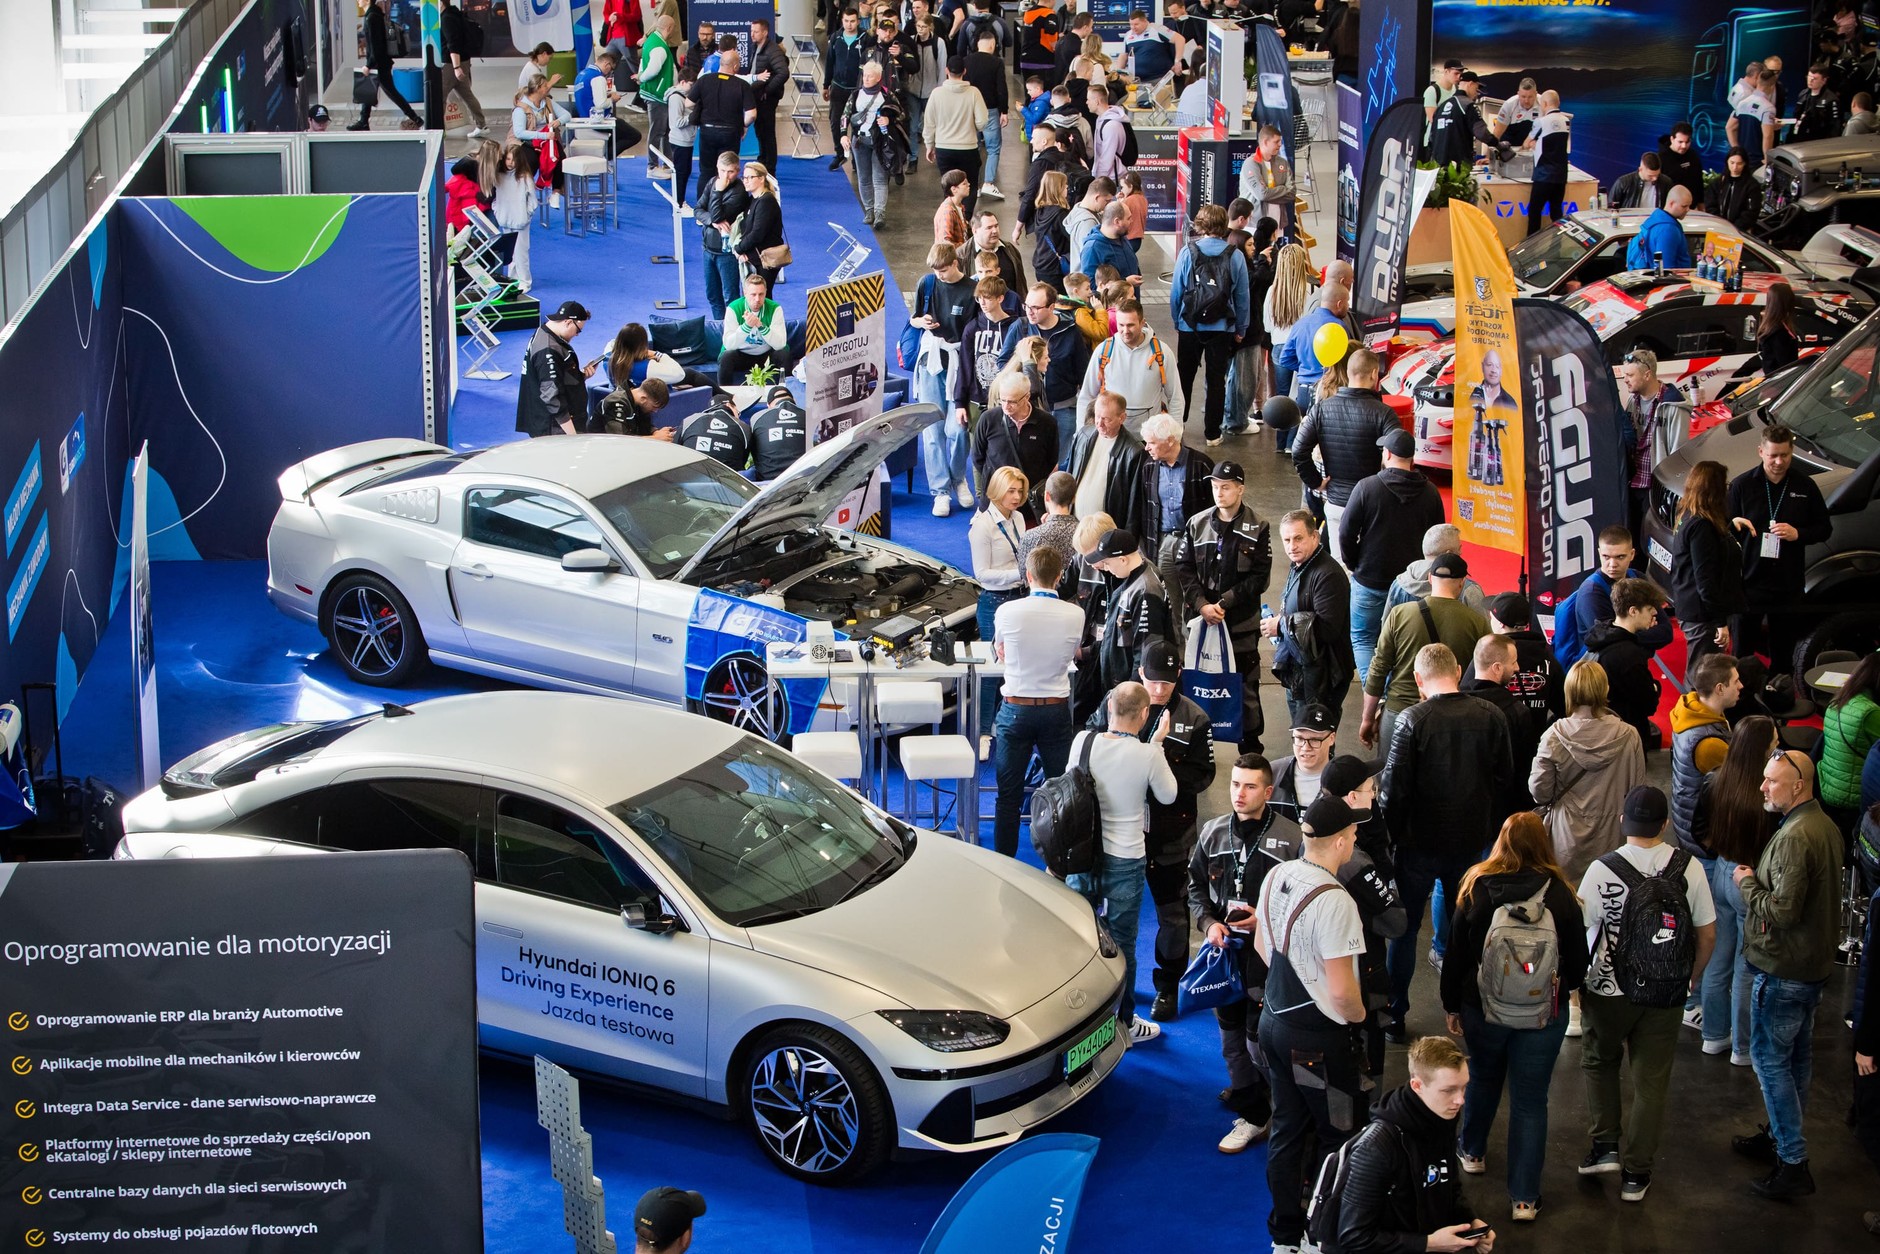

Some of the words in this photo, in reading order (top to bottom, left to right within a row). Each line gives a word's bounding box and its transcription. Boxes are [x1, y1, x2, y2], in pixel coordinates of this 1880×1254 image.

[1232, 152, 1254, 160] TREC
[1232, 160, 1244, 168] SE
[1371, 137, 1402, 303] DUDA
[822, 335, 869, 358] PRZYGOTUJ
[1193, 686, 1231, 699] TEXA
[1656, 928, 1676, 938] NIKE
[4, 937, 211, 966] Oprogramowanie
[217, 934, 252, 955] dla
[259, 929, 391, 957] motoryzacji
[519, 946, 597, 978] Hyundai
[602, 965, 658, 996] IONIQ
[663, 979, 676, 996] 6
[501, 966, 565, 999] Driving
[570, 983, 674, 1021] Experience
[36, 1011, 157, 1028] Oprogramowanie
[160, 1011, 185, 1022] ERP
[189, 1009, 210, 1021] dla
[213, 1007, 260, 1022] branży
[262, 1005, 343, 1018] Automotive
[541, 1000, 596, 1027] Jazda
[601, 1014, 675, 1045] testowa
[40, 1056, 103, 1072] Aplikacje
[106, 1056, 161, 1068] mobilne
[165, 1054, 186, 1066] dla
[189, 1051, 277, 1065] mechaników
[280, 1050, 284, 1062] i
[287, 1048, 360, 1062] kierowców
[1071, 1044, 1083, 1070] PY
[43, 1102, 93, 1115] Integra
[97, 1101, 128, 1112] Data
[132, 1099, 180, 1111] Service
[191, 1097, 225, 1109] dane
[228, 1093, 376, 1108] serwisowo-naprawcze
[46, 1138, 113, 1153] Platformy
[116, 1135, 200, 1148] internetowe
[203, 1134, 220, 1146] do
[223, 1132, 290, 1147] sprzedaży
[293, 1129, 371, 1145] części/opon
[47, 1148, 110, 1163] eKatalogi
[122, 1148, 166, 1162] sklepy
[168, 1145, 252, 1158] internetowe
[48, 1187, 116, 1200] Centralne
[119, 1186, 149, 1199] bazy
[153, 1183, 202, 1198] danych
[205, 1182, 226, 1194] dla
[229, 1181, 258, 1194] sieci
[261, 1178, 347, 1194] serwisowych
[53, 1231, 110, 1245] Systemy
[113, 1228, 130, 1240] do
[133, 1226, 182, 1241] obsługi
[185, 1225, 248, 1241] pojazdów
[251, 1222, 318, 1237] flotowych
[1040, 1197, 1065, 1254] ZACJI
